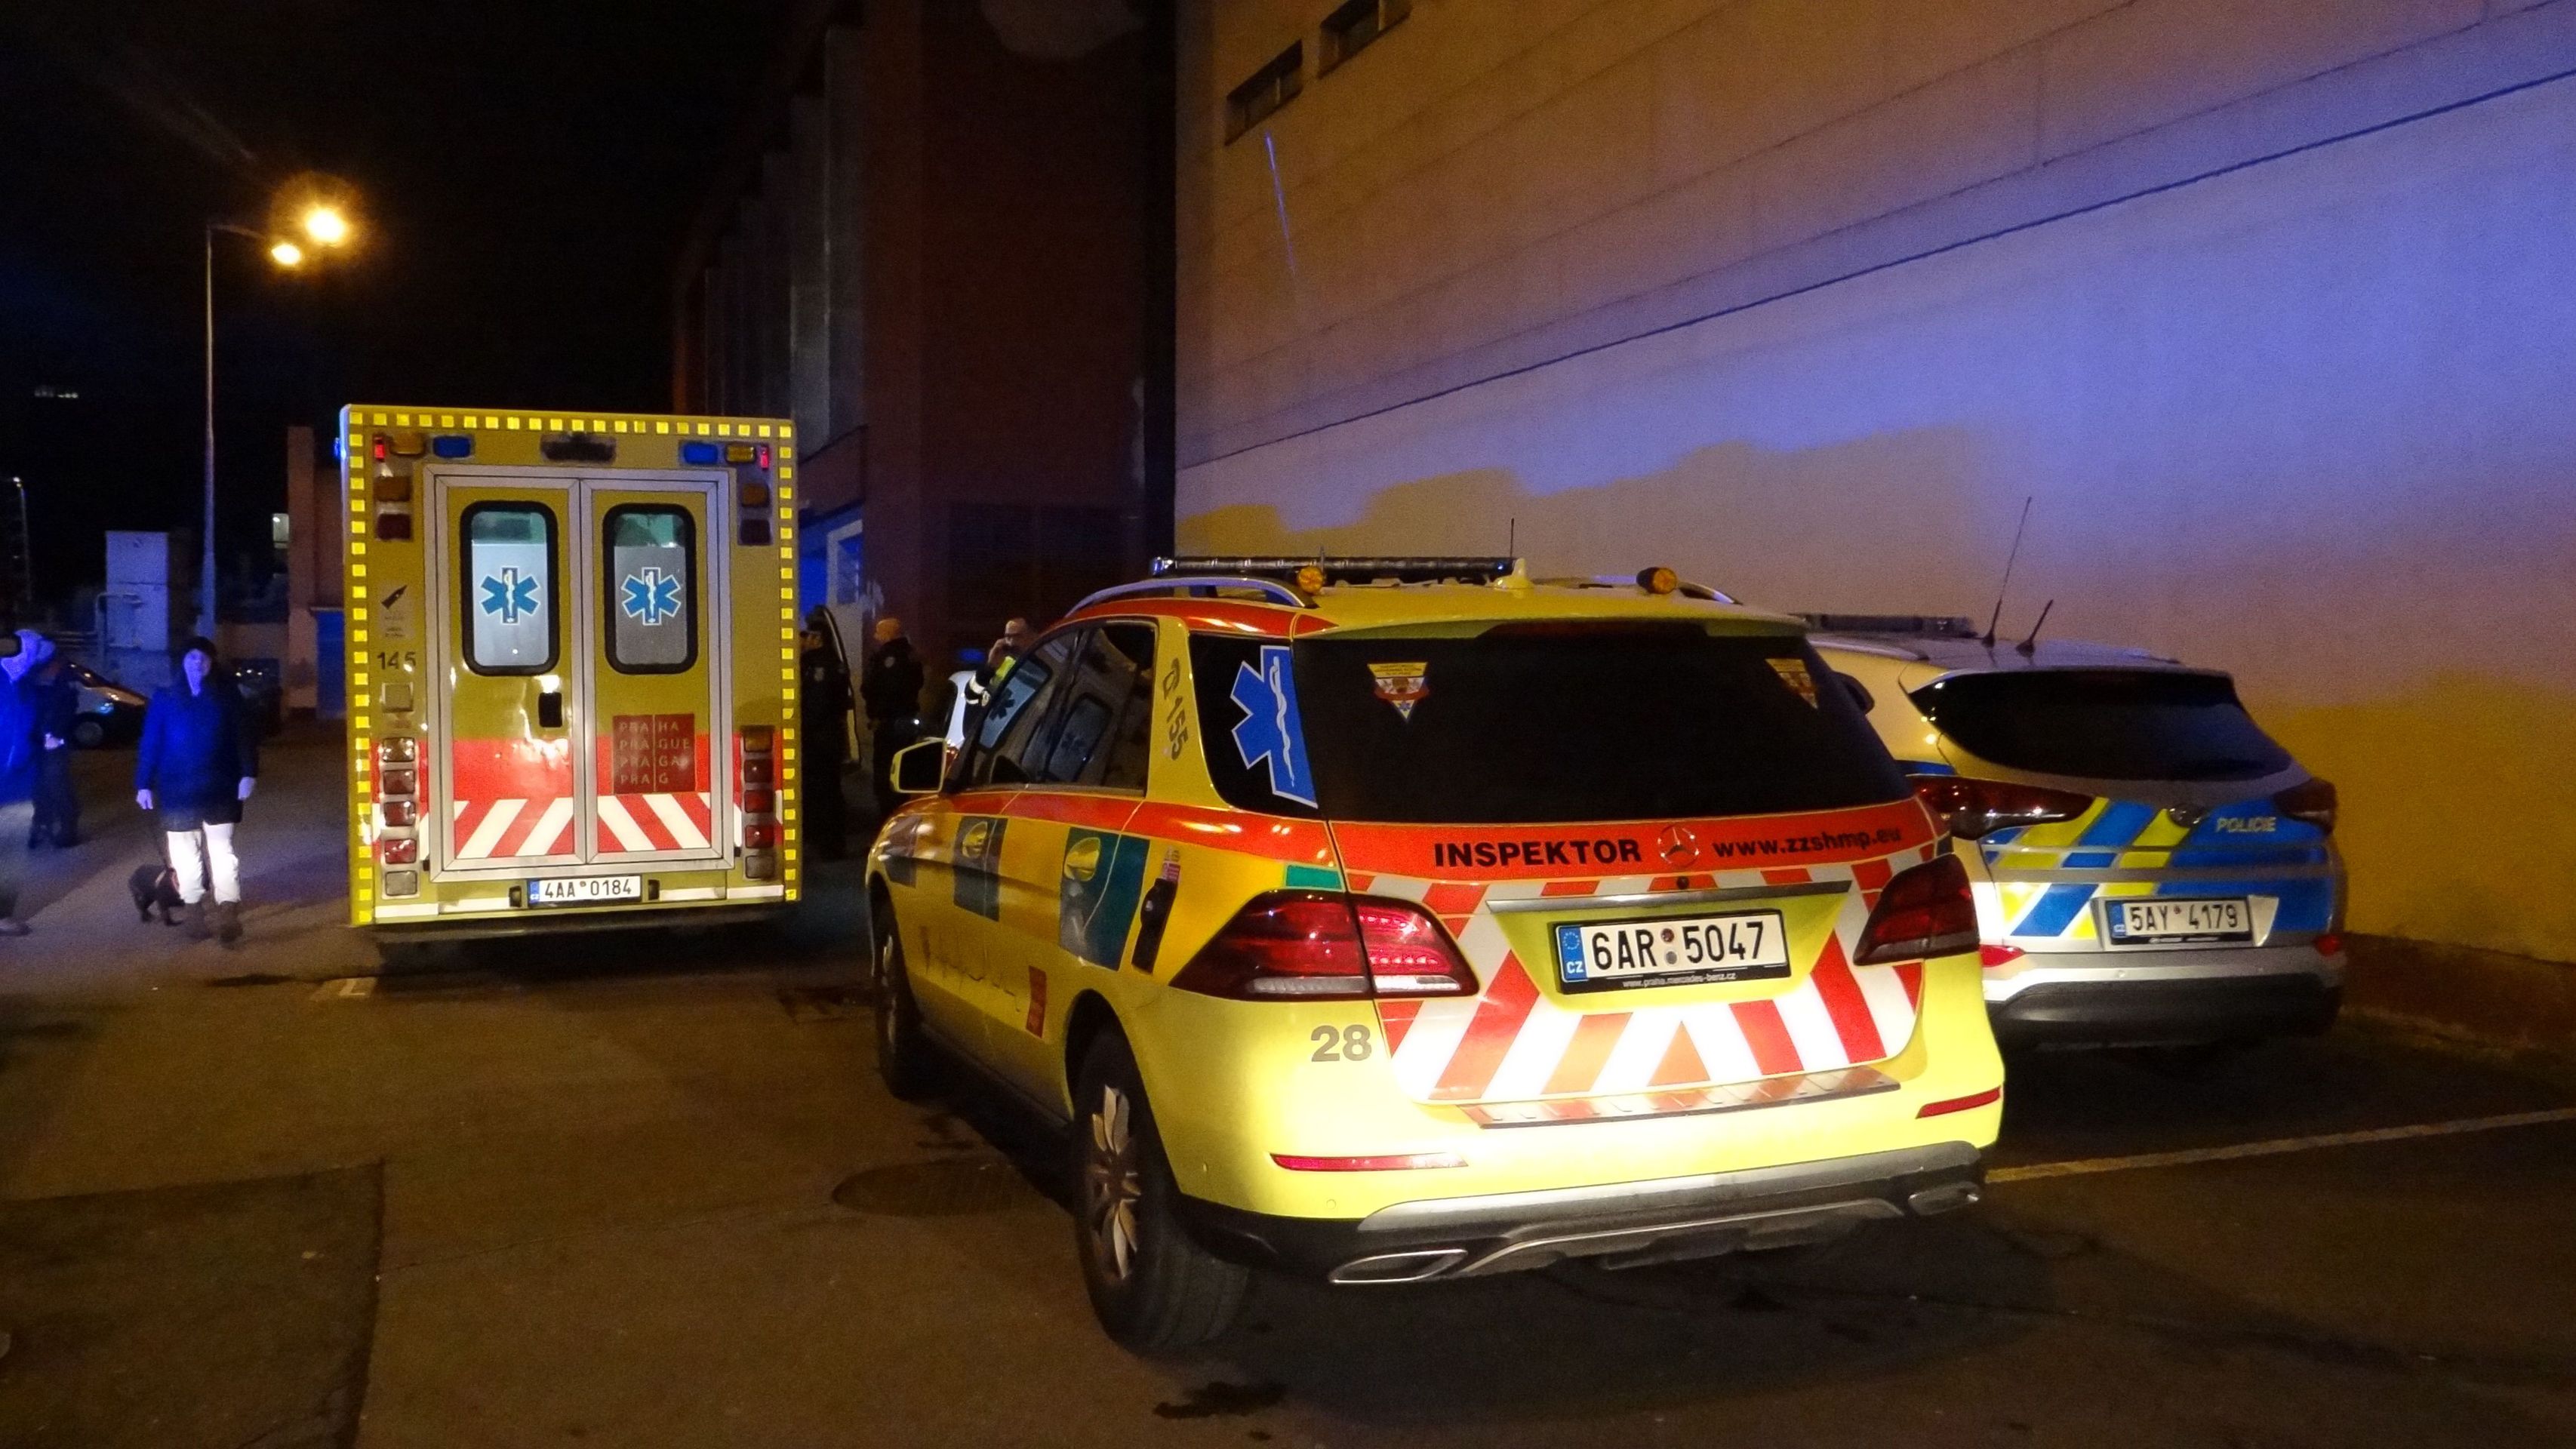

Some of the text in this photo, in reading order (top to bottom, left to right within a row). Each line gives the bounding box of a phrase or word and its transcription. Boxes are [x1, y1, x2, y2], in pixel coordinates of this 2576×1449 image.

[377, 651, 416, 670] 145
[1434, 838, 1642, 867] INSPEKTOR
[1712, 828, 1901, 858] www.zzshmp.eu
[545, 879, 632, 898] 4AA 0184
[1592, 921, 1764, 971] 6AR 5047
[1566, 961, 1584, 974] CZ
[1311, 1024, 1372, 1062] 28
